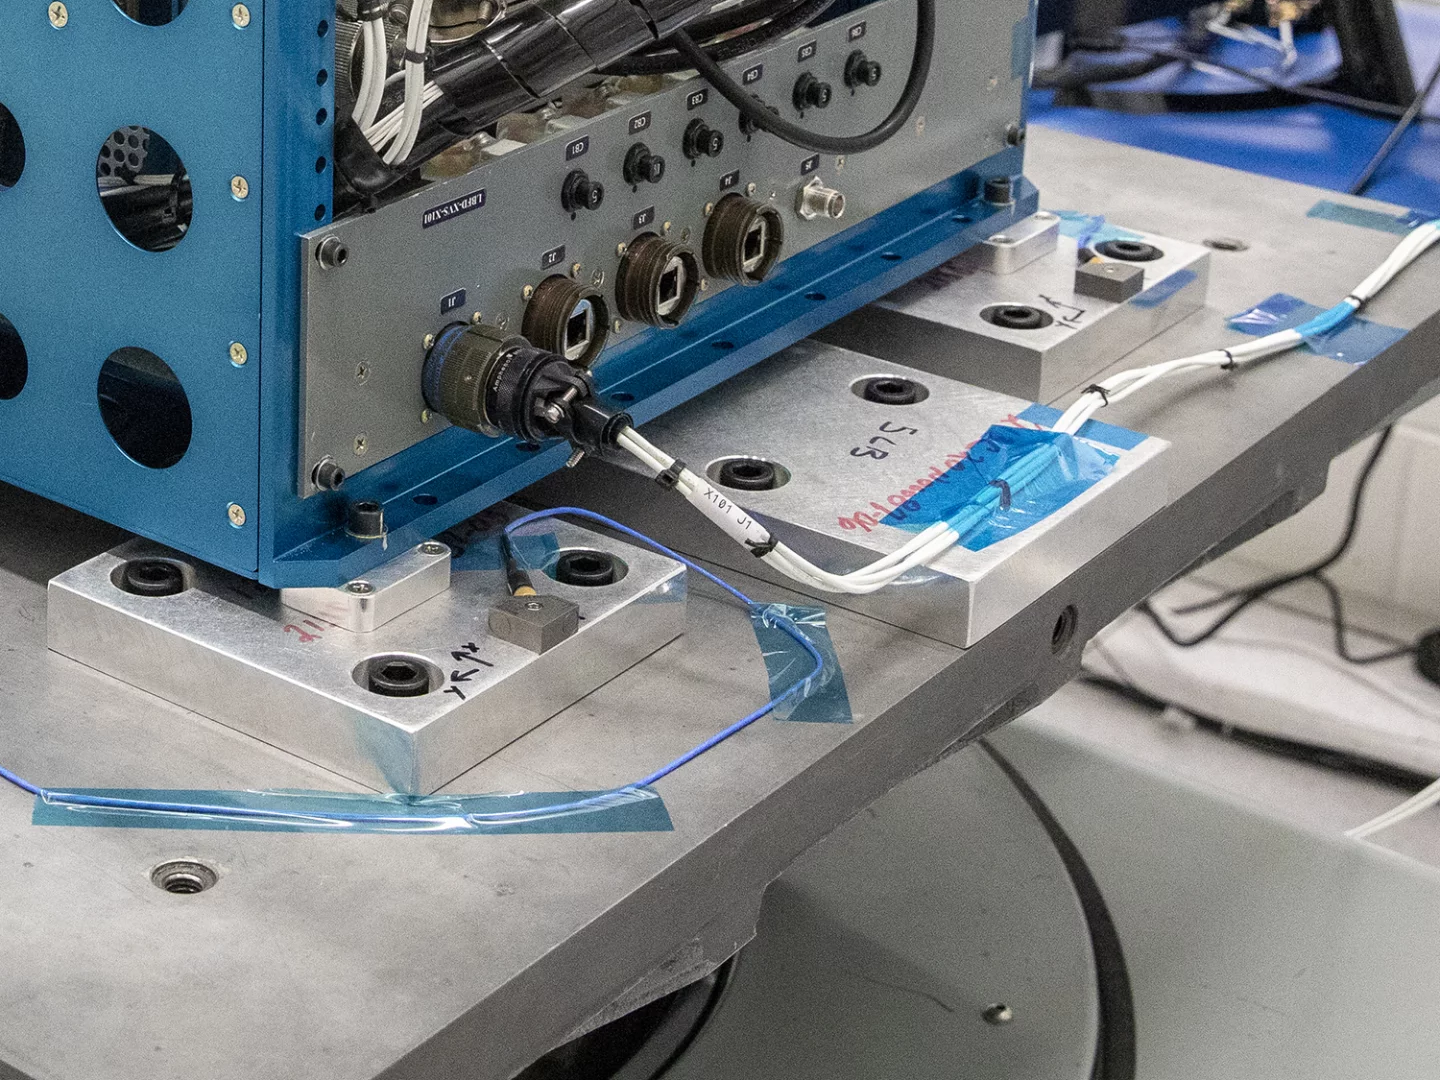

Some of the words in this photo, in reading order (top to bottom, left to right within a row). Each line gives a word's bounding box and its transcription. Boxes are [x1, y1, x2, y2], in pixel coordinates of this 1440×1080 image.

[747, 69, 759, 81] CB4
[691, 93, 704, 106] CB3
[634, 117, 646, 129] CB2
[572, 142, 584, 155] CB1
[548, 252, 557, 263] J2
[448, 296, 456, 308] J1
[703, 487, 733, 514] X101
[736, 516, 752, 530] J1
